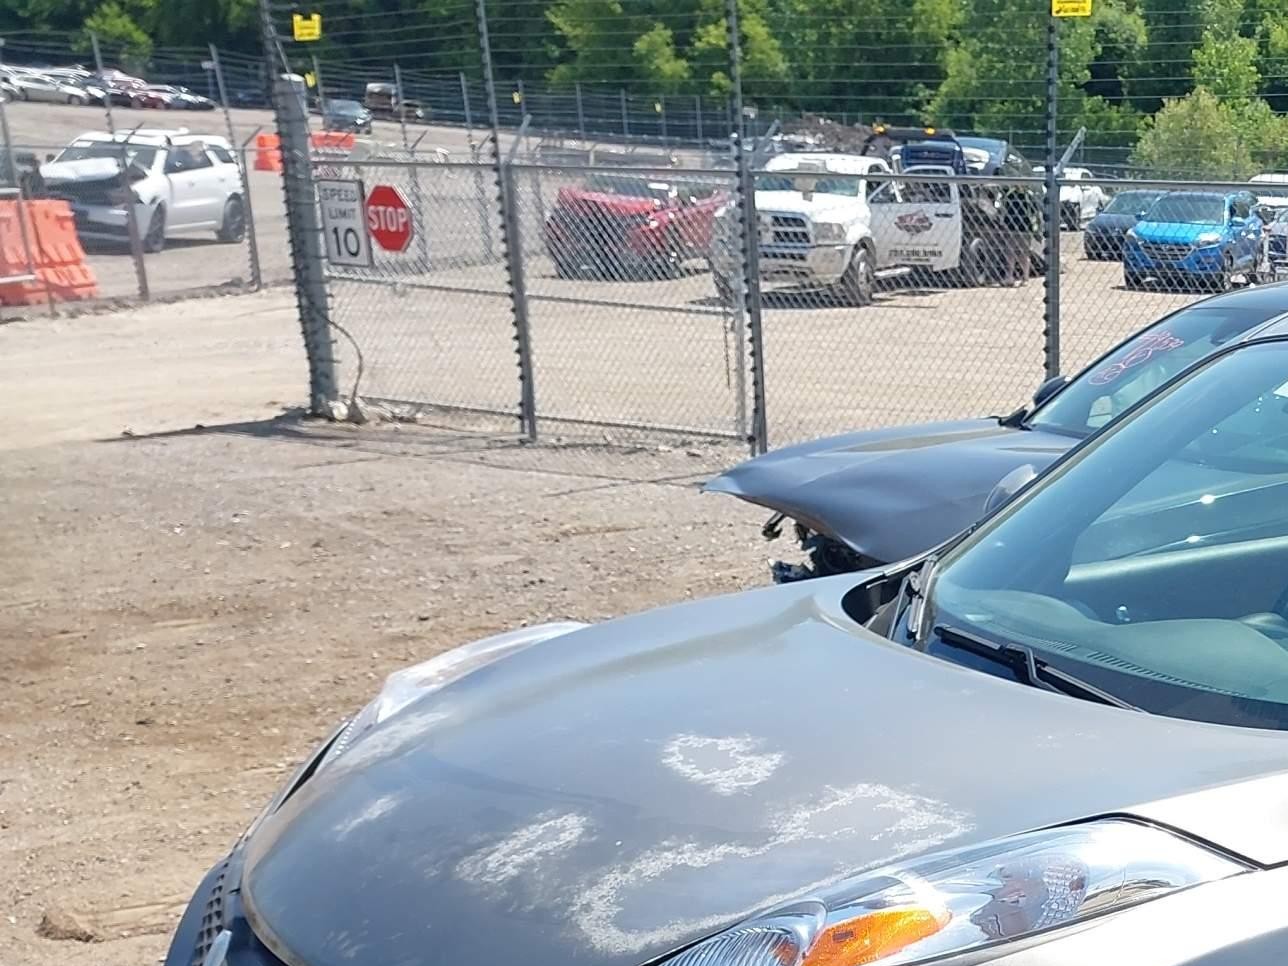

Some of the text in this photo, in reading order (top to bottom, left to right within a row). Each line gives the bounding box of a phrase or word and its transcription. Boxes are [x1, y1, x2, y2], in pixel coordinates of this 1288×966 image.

[322, 188, 357, 202] SPEED
[328, 208, 356, 220] LIMIT
[368, 205, 408, 232] STOP
[333, 227, 360, 257] 10
